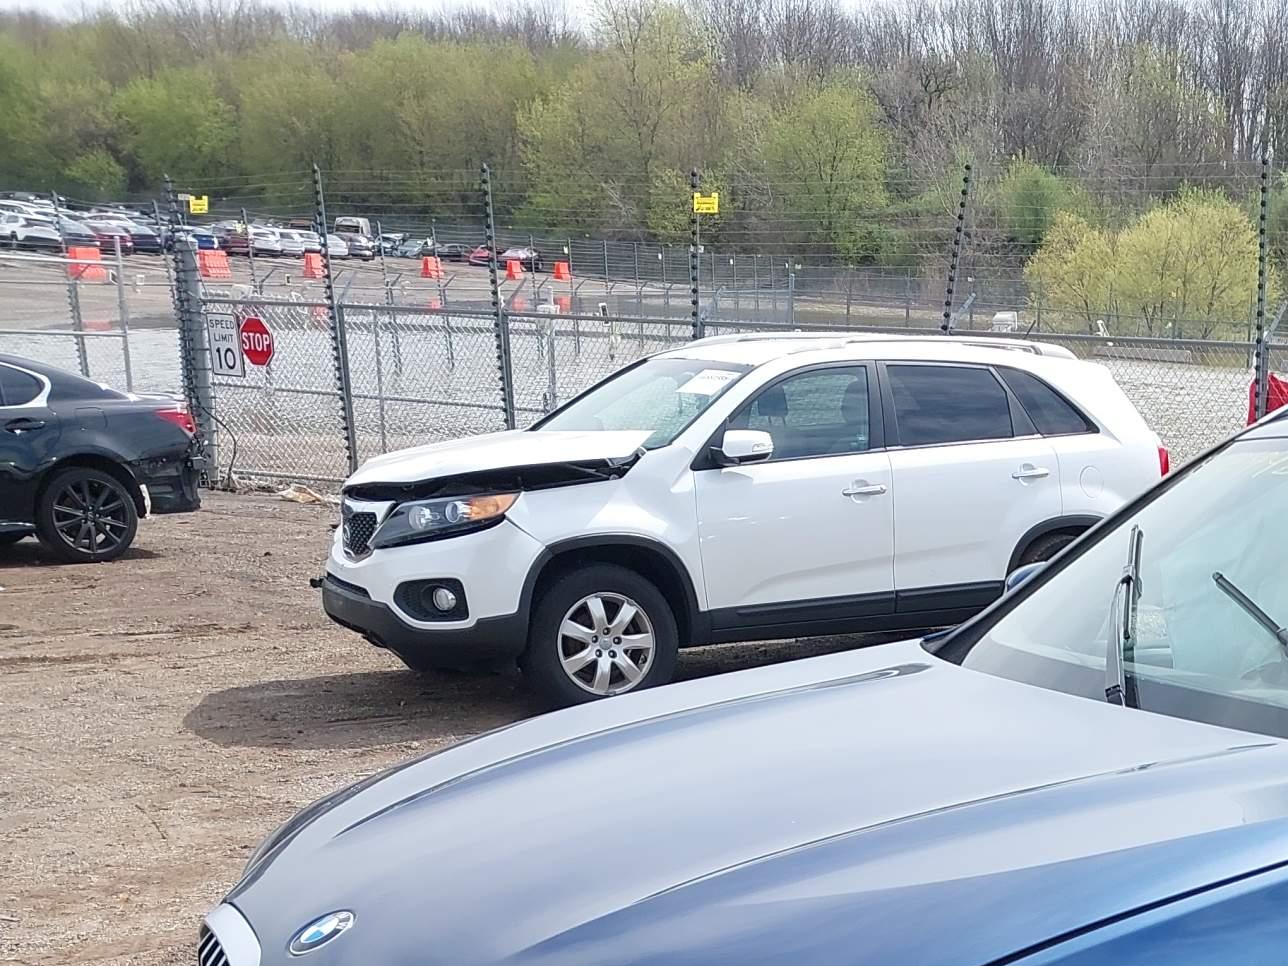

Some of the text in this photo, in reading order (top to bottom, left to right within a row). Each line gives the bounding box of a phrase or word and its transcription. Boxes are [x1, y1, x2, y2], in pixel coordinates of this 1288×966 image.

[209, 319, 235, 330] SPEED
[213, 332, 234, 343] LIMIT
[242, 332, 270, 352] STOP
[215, 346, 237, 370] 10
